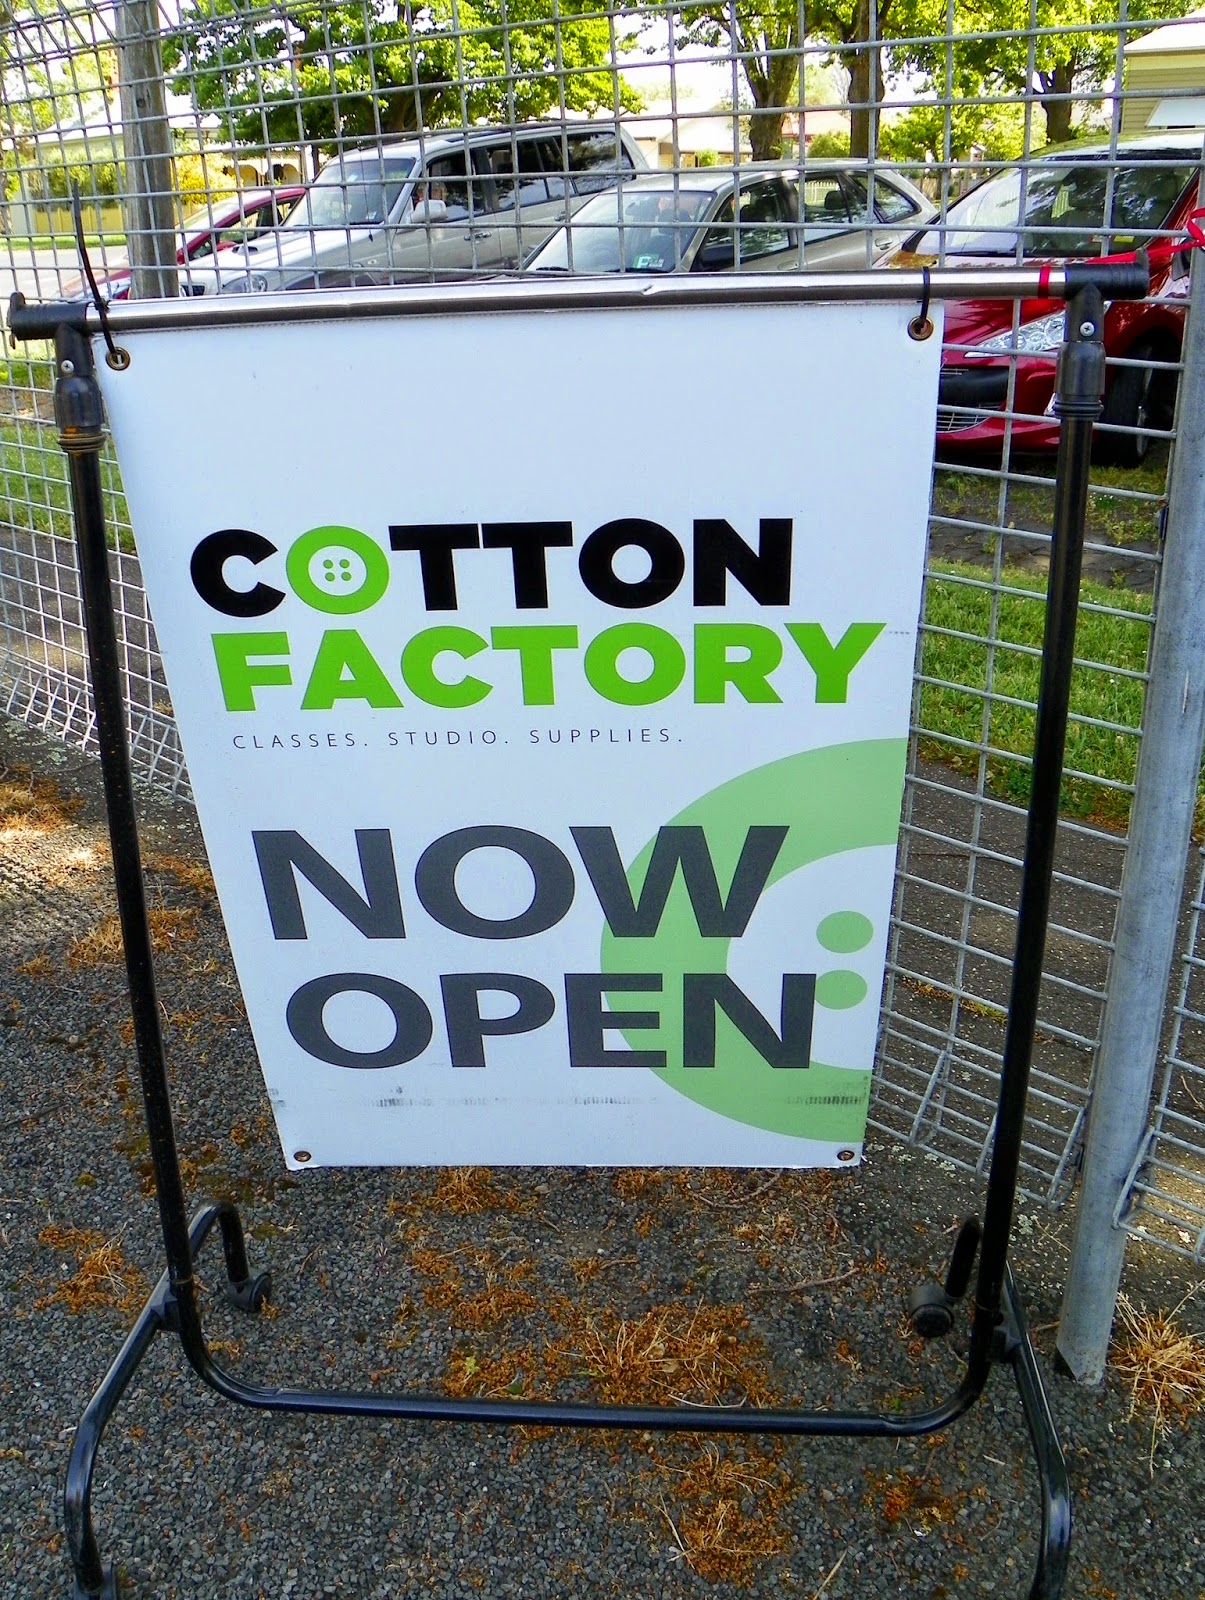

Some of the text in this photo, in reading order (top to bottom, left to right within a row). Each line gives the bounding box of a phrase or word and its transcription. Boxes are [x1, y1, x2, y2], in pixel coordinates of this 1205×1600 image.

[190, 518, 793, 616] COTTON
[211, 622, 887, 711] FACTORY
[233, 728, 682, 749] CLASSES. STUDIO. SUPPLIES.
[251, 825, 790, 939] NOW
[286, 973, 816, 1069] OPEN
